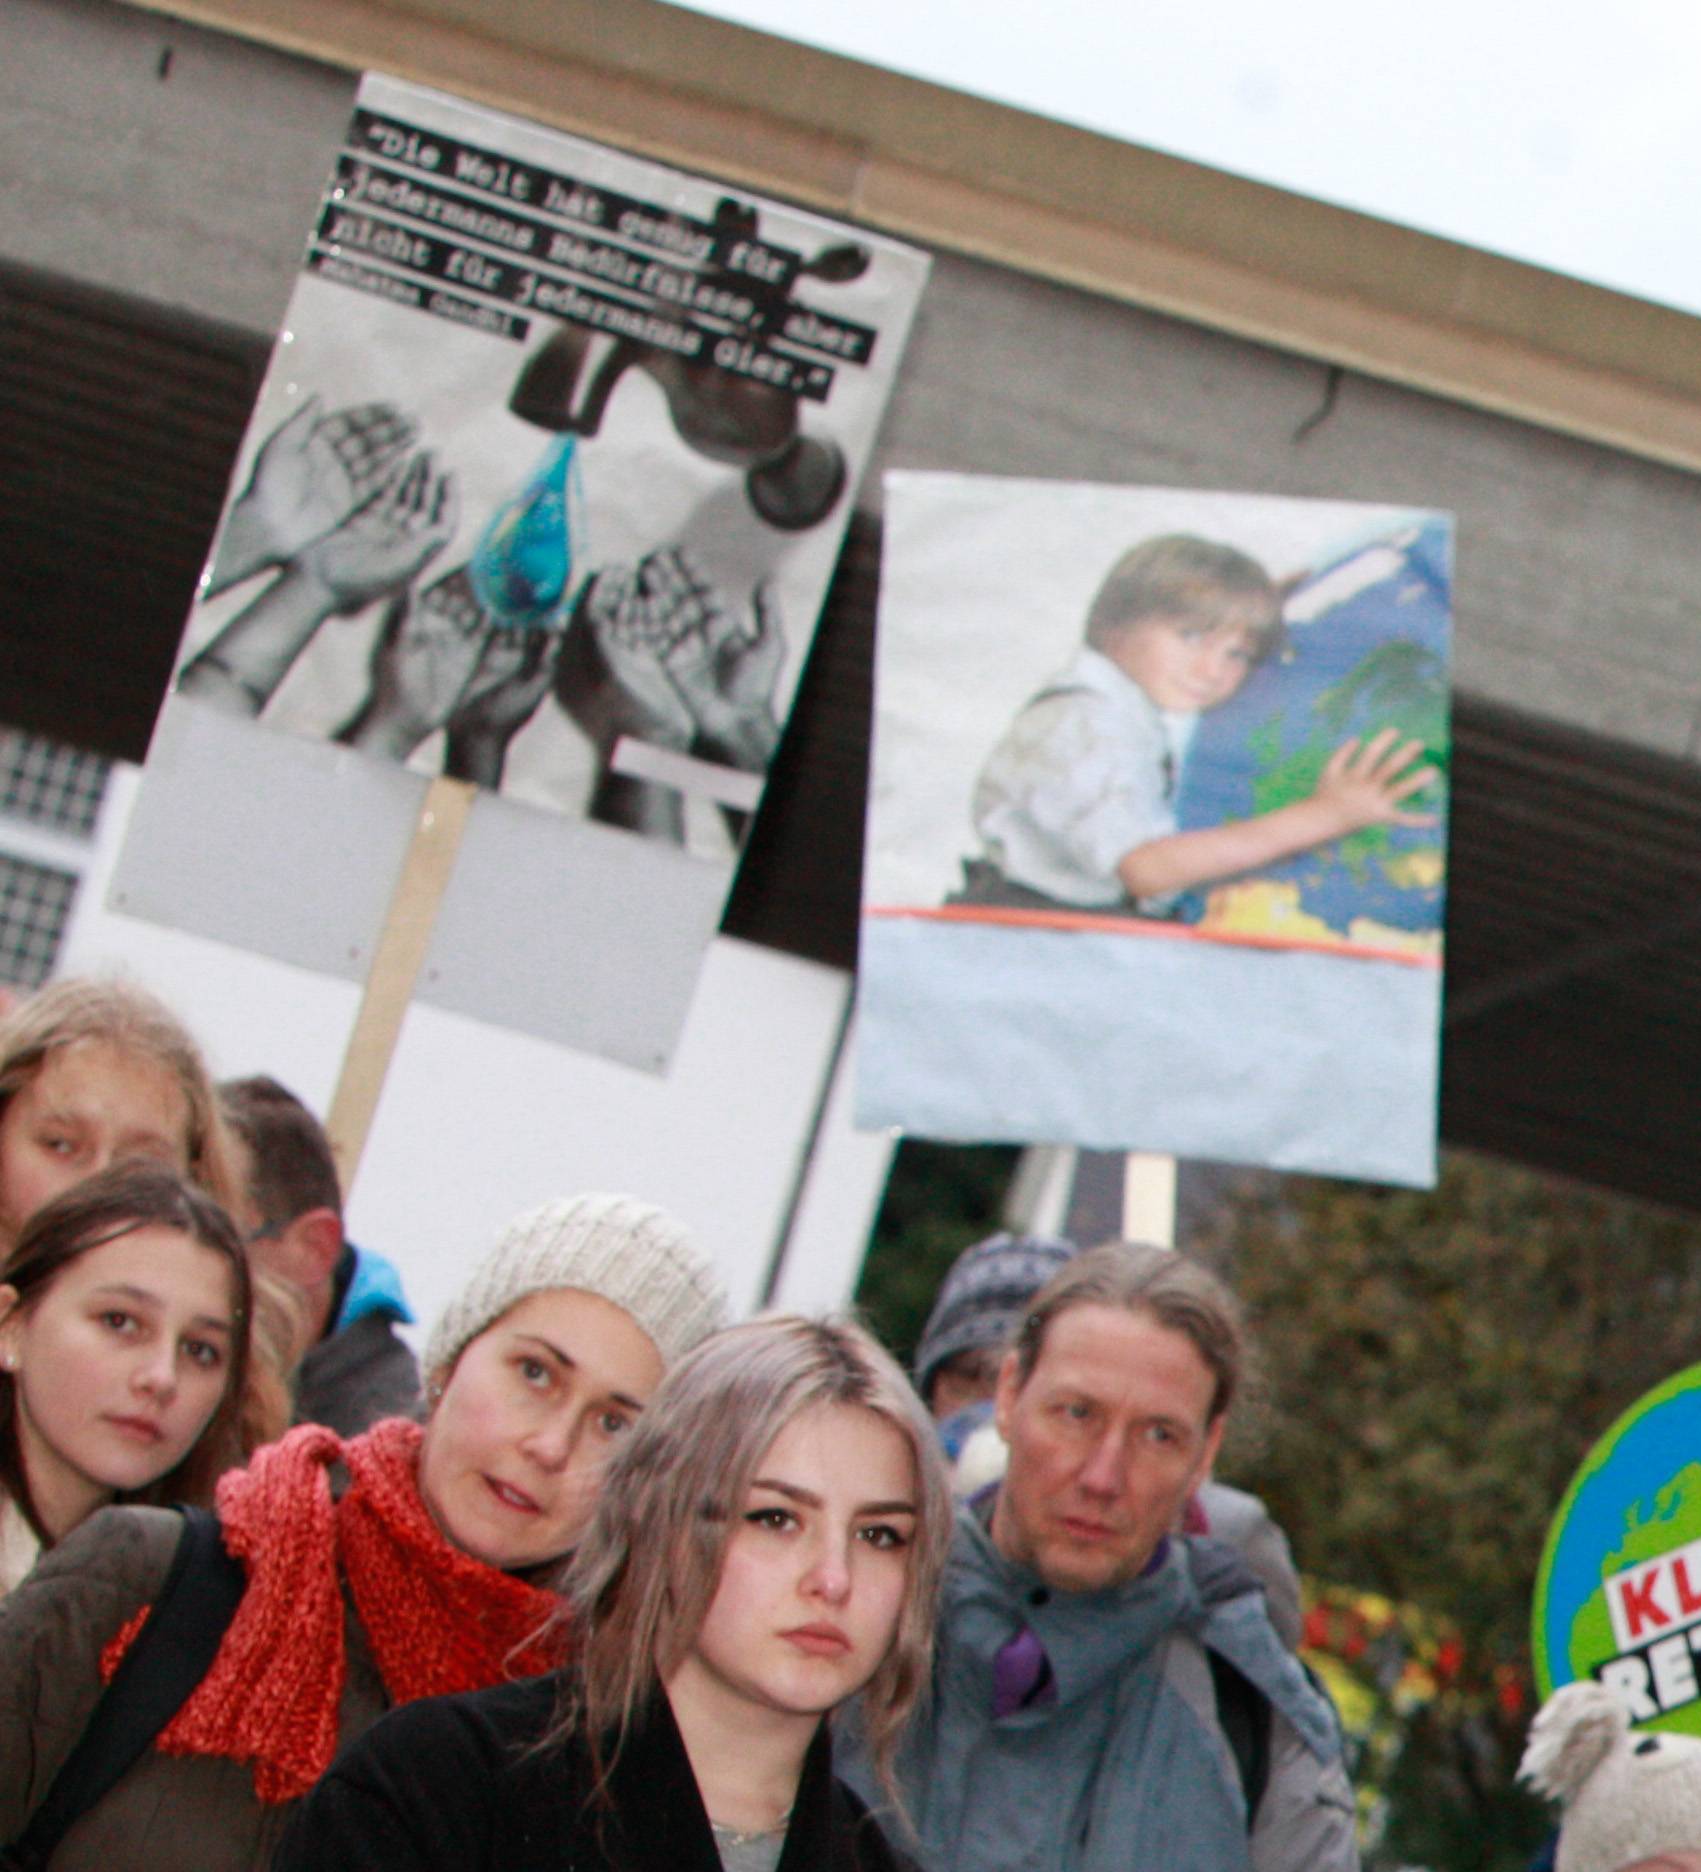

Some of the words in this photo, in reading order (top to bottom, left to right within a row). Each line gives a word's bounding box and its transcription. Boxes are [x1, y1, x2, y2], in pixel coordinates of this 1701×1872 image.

[329, 213, 431, 268] nicht
[442, 248, 504, 292] für
[512, 273, 704, 358] jedermanns
[348, 163, 537, 250] jedermanns
[547, 232, 768, 329] Bedürfnisse,
[783, 312, 866, 357] aber
[454, 149, 532, 202] Welt
[543, 181, 605, 225] hat
[617, 209, 716, 264] genug
[726, 239, 790, 285] für
